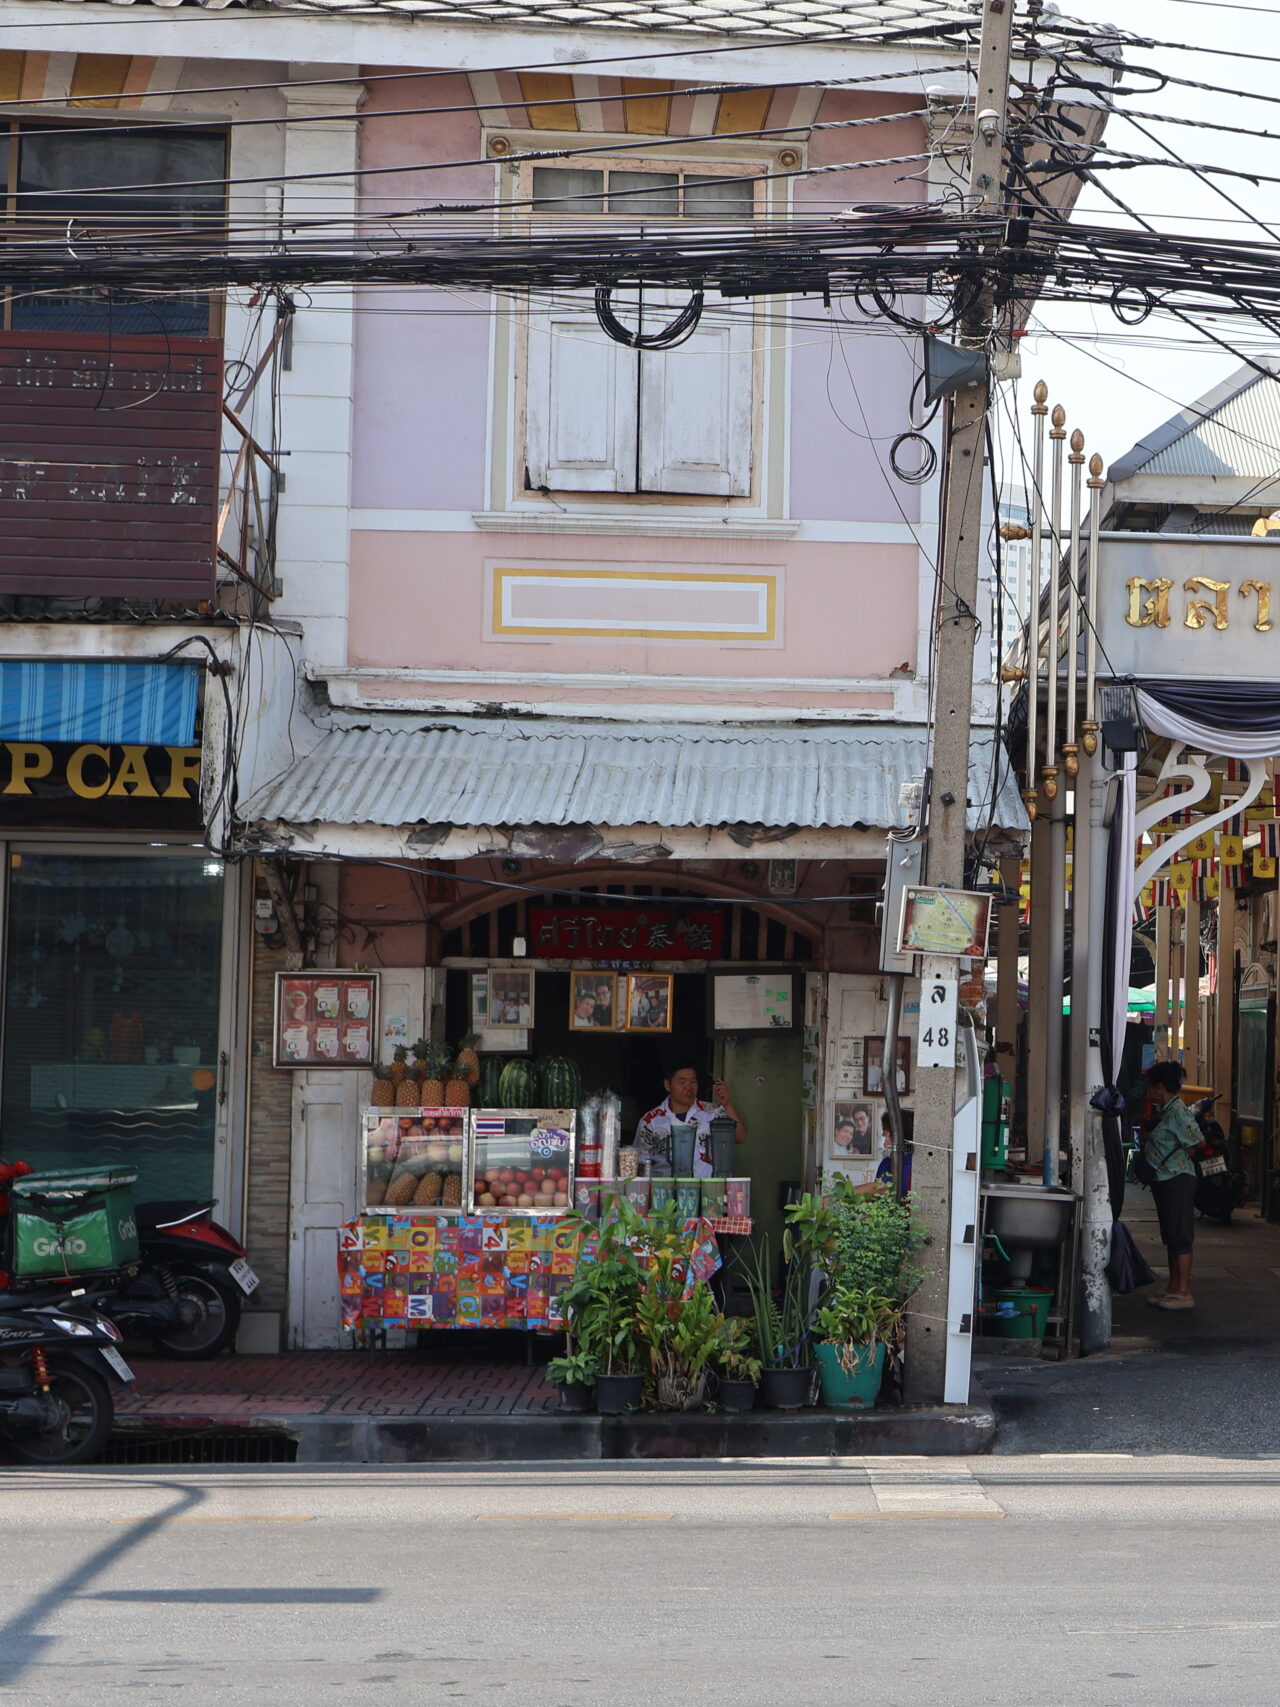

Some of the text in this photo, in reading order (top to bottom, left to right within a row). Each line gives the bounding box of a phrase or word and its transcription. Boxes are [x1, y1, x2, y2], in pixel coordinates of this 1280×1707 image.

[0, 743, 53, 795] P
[922, 1027, 949, 1047] 48
[118, 1216, 137, 1241] Grab
